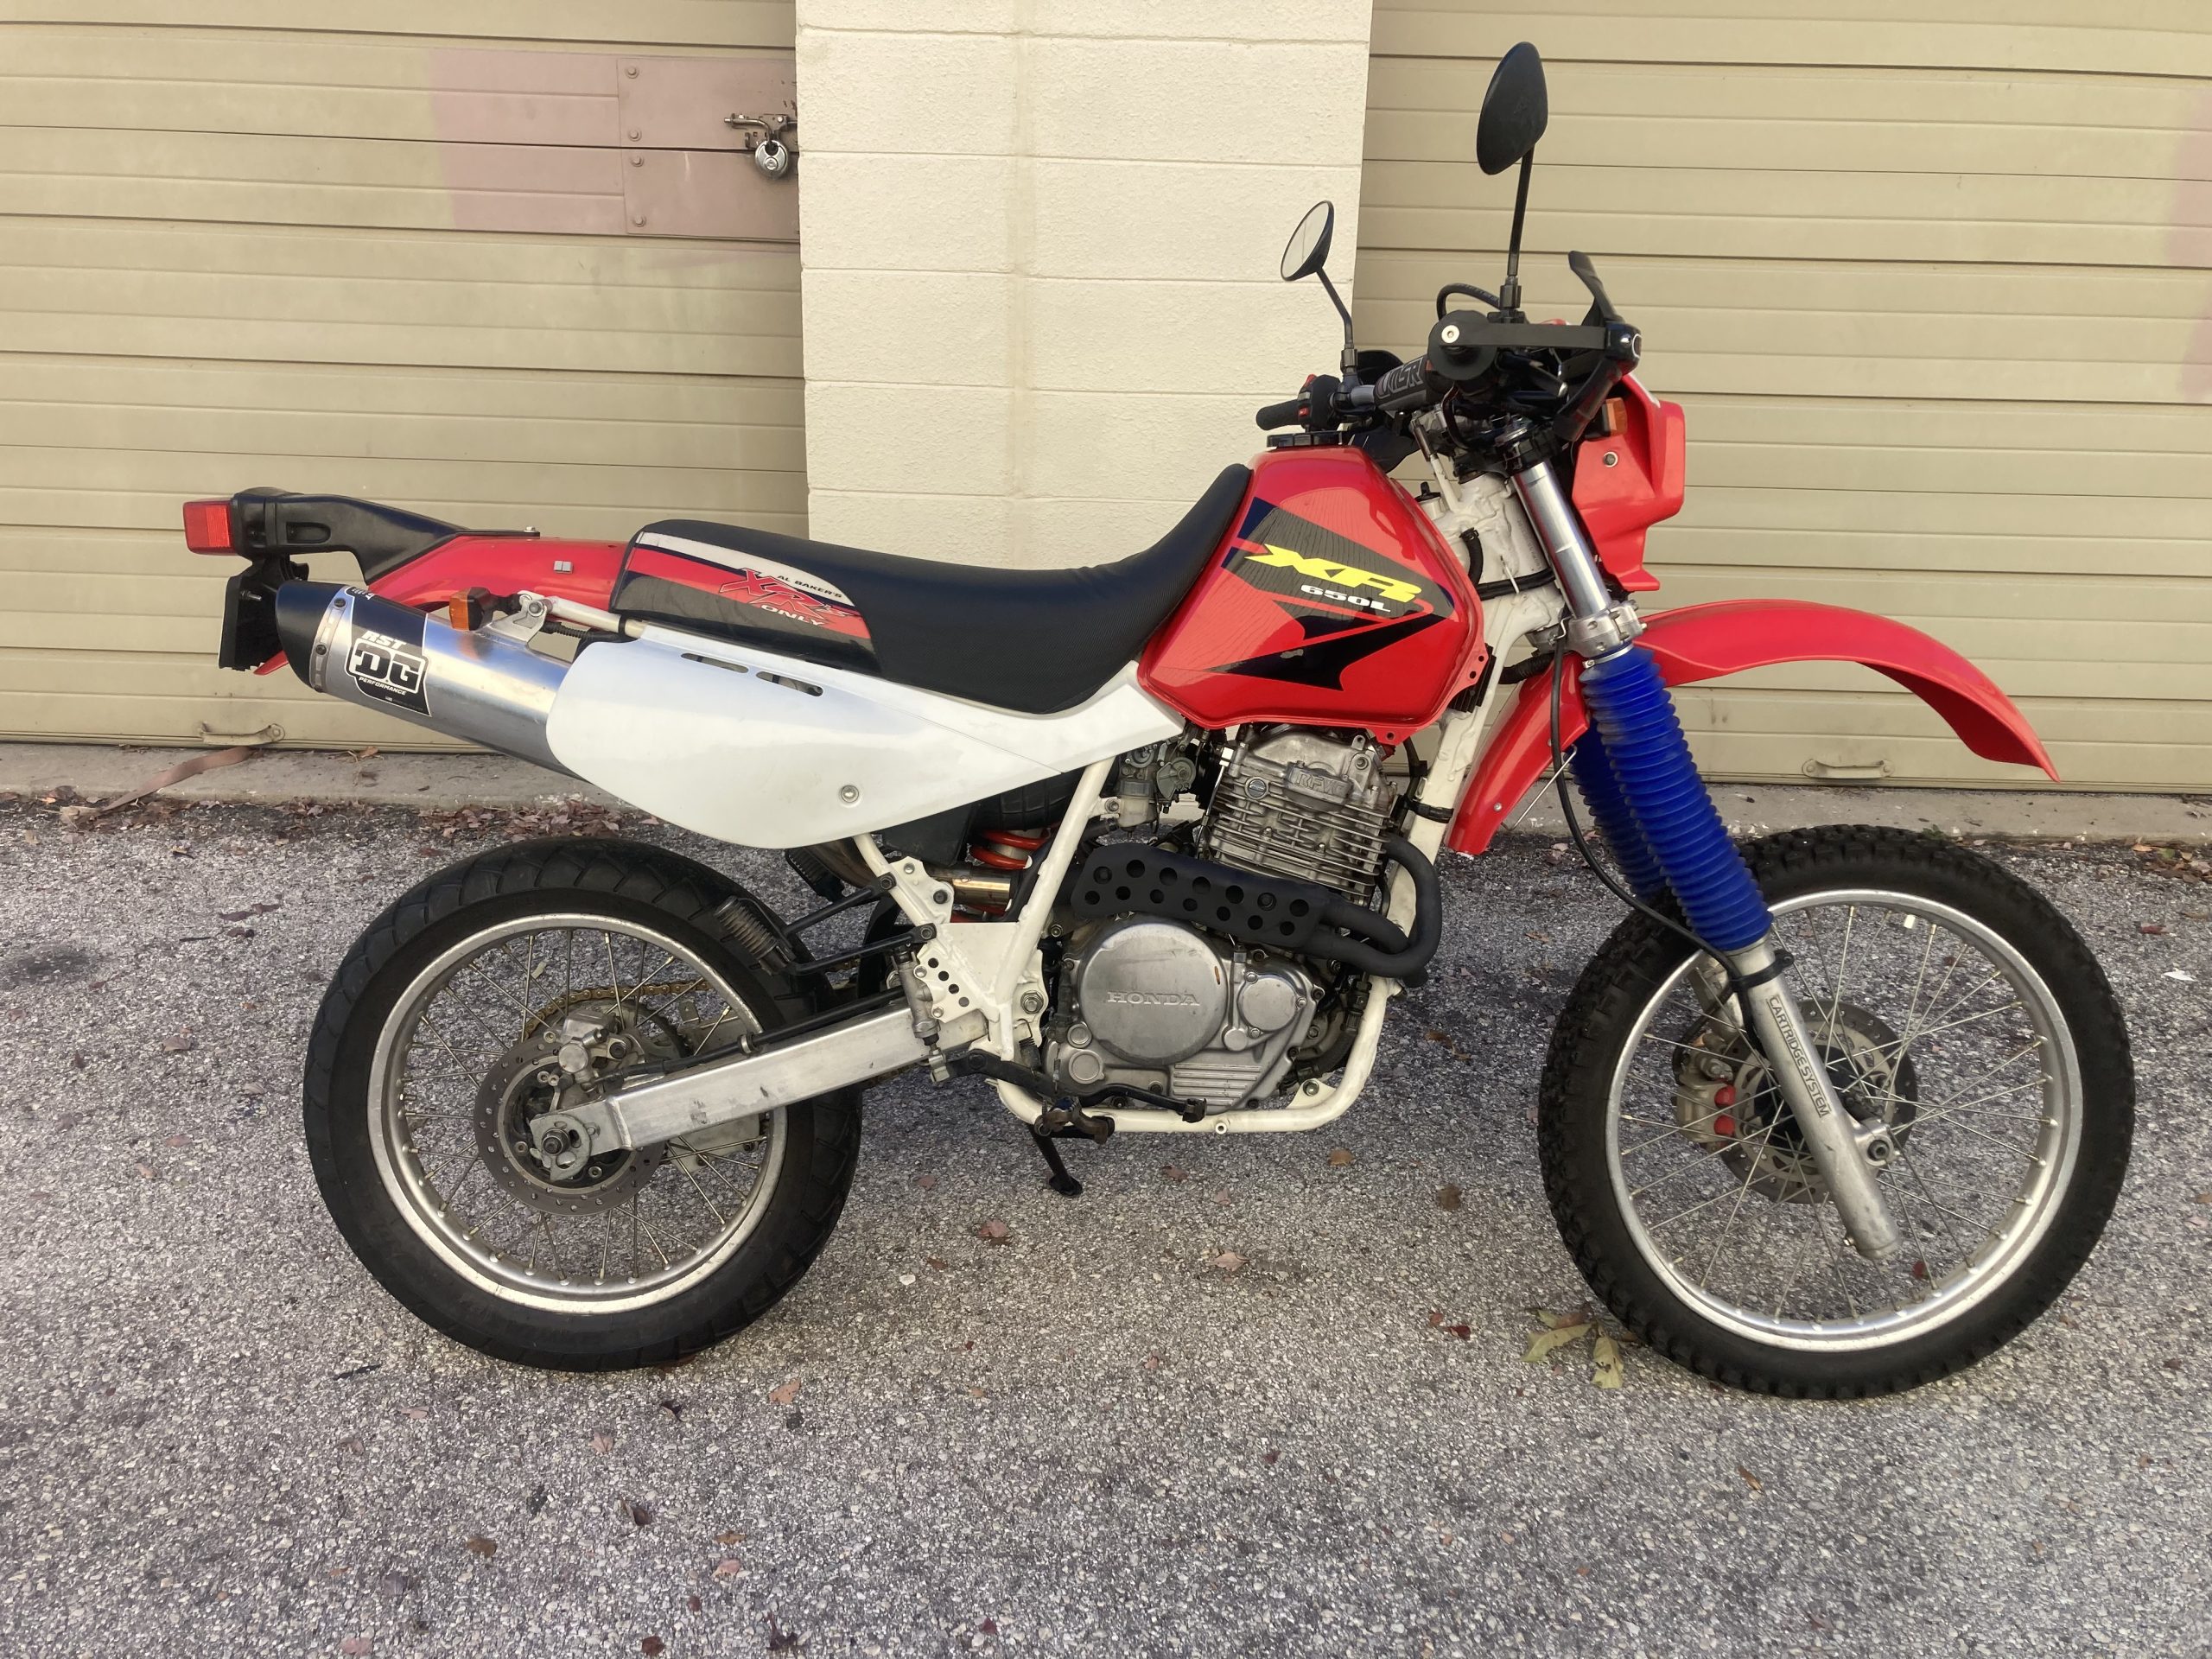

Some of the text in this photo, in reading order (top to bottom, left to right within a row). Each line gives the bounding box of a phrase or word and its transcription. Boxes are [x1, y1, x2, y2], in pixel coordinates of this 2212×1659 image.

[1244, 543, 1421, 602] XR
[794, 580, 842, 598] BAKER'S
[1300, 584, 1390, 613] 650L
[761, 604, 825, 626] ONLY
[360, 630, 407, 649] RST
[354, 640, 422, 693] DG
[359, 676, 407, 696] PERFORMANCE
[1107, 990, 1200, 1007] HONDA
[1770, 995, 1831, 1117] CARTRIDGE SYSTEM
